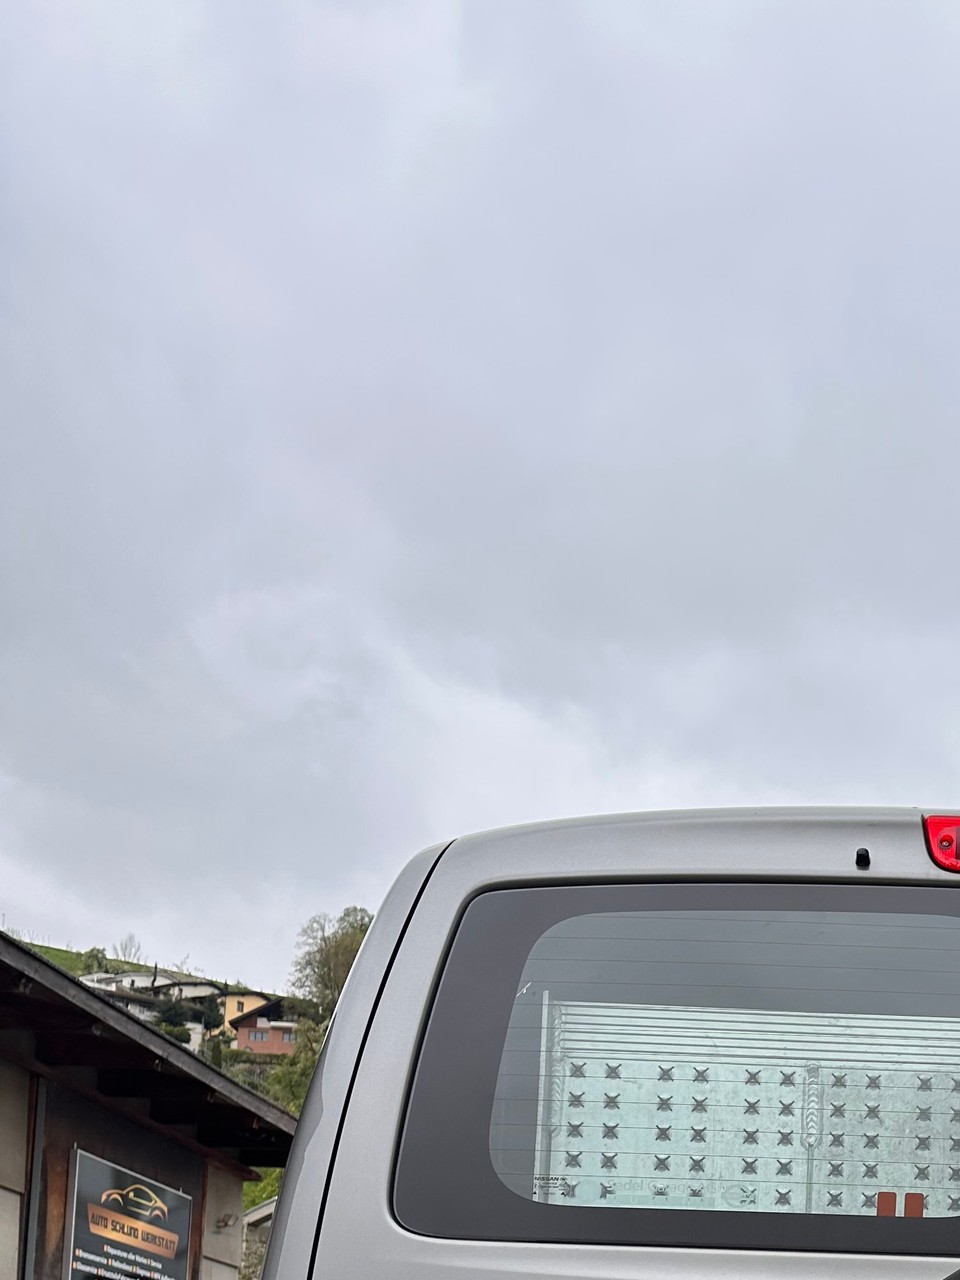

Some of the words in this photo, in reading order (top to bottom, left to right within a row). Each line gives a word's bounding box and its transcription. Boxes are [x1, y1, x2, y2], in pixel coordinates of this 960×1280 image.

[91, 1213, 108, 1229] AUTO
[111, 1219, 139, 1239] SCHLUND
[141, 1230, 176, 1252] WERKSTATT
